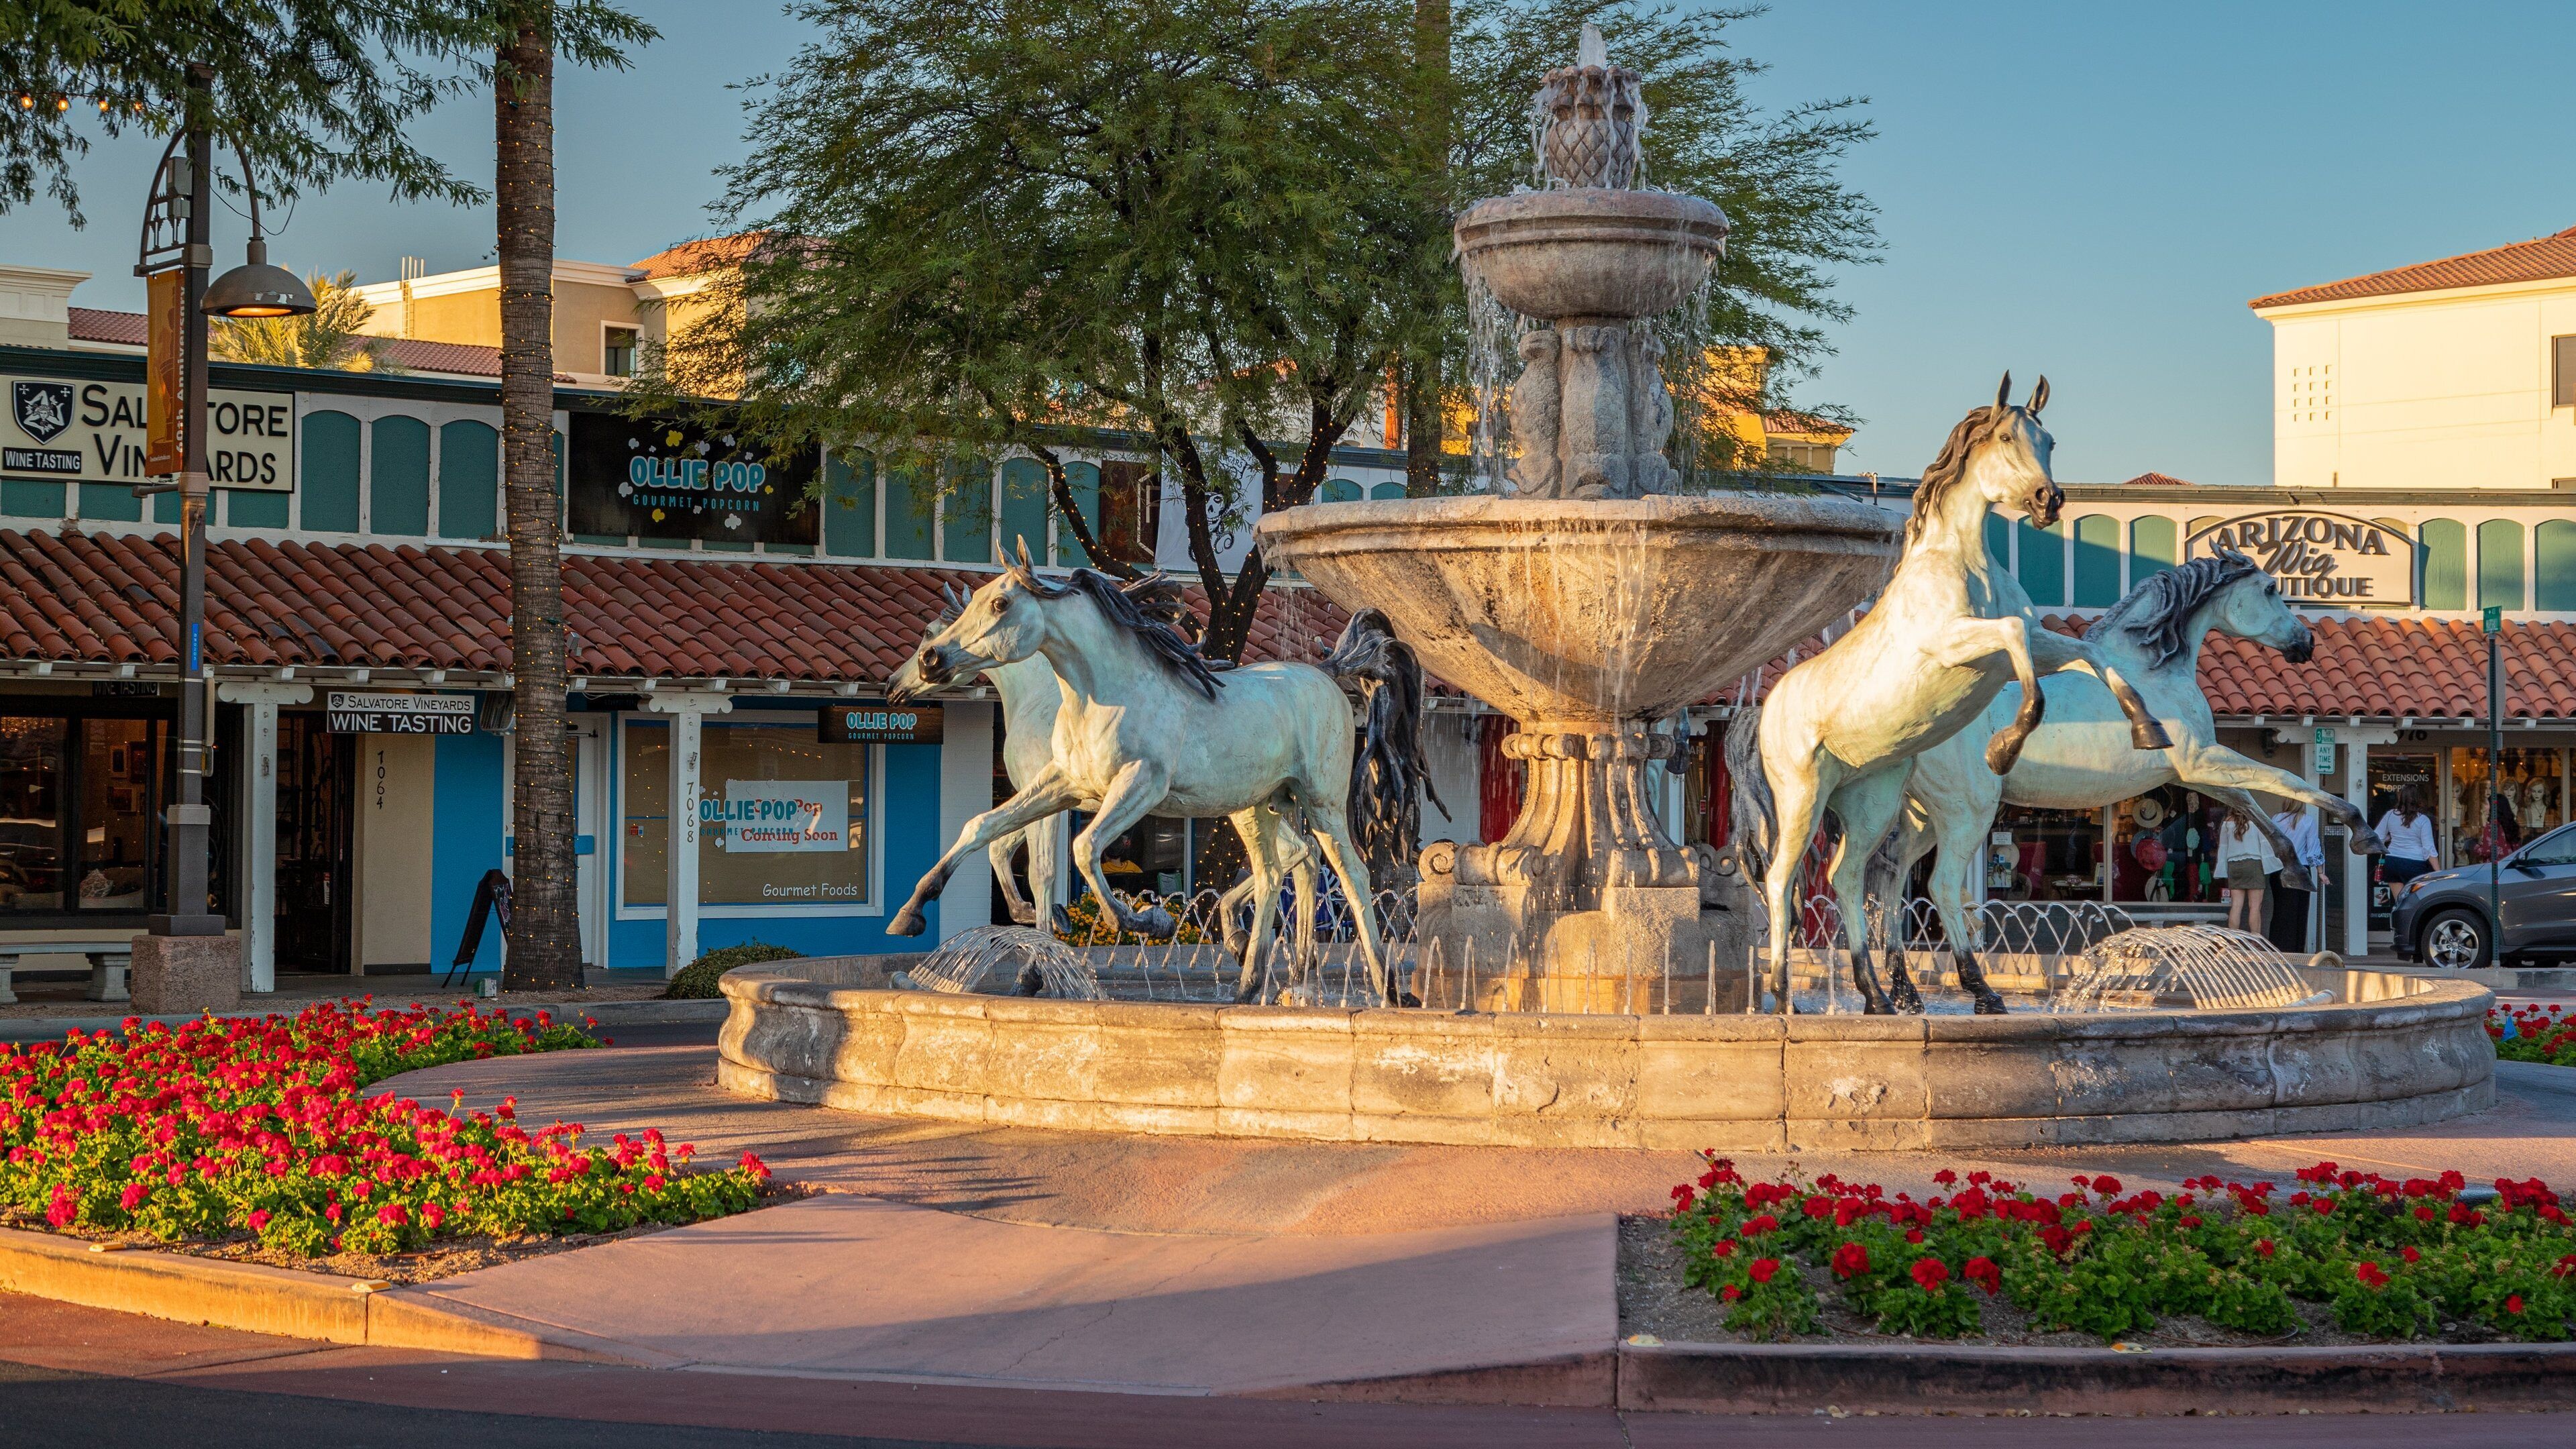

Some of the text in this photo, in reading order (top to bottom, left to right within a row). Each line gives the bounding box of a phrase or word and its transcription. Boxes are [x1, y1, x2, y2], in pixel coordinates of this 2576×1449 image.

[82, 384, 288, 437] SALORE
[175, 409, 184, 453] 60th
[5, 450, 80, 470] WINE TASTING
[629, 455, 765, 492] OLLIE POP
[633, 494, 759, 512] GOURMET POPCORN
[2212, 516, 2390, 555] ARIZONA
[2257, 540, 2337, 588] Wig
[348, 695, 470, 711] SALVATORE VINEYARDS
[331, 713, 472, 733] WINE TASTING
[847, 712, 917, 730] OLLIE POP
[2319, 747, 2331, 755] ANY
[2382, 773, 2430, 782] EXTENSIONS
[686, 782, 694, 843] 7068
[699, 798, 756, 822] OLLIE
[759, 798, 798, 822] POP
[741, 828, 839, 845] Coming Soon
[763, 883, 857, 897] Gourmet Foods
